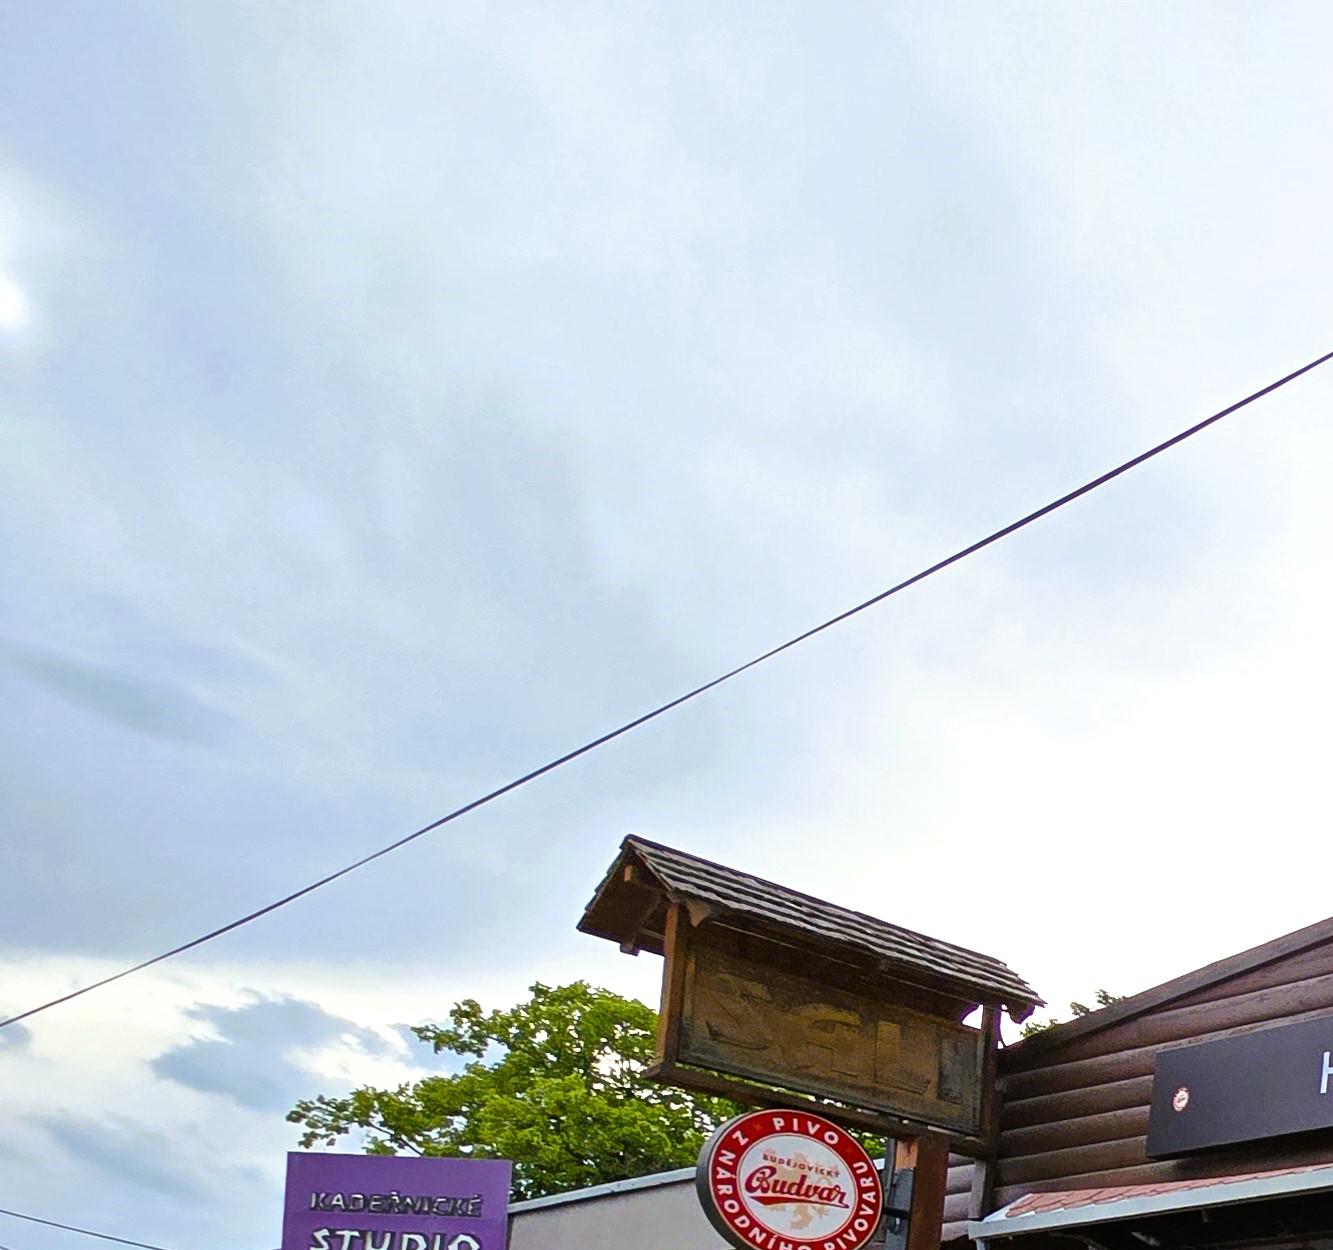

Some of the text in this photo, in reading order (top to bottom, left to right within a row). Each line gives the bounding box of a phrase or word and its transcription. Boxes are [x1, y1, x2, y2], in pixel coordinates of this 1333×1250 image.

[731, 1129, 750, 1147] Z
[771, 1116, 840, 1146] PIVO
[744, 1165, 849, 1206] Budvar
[309, 1189, 484, 1218] KADEŘNICKÉ
